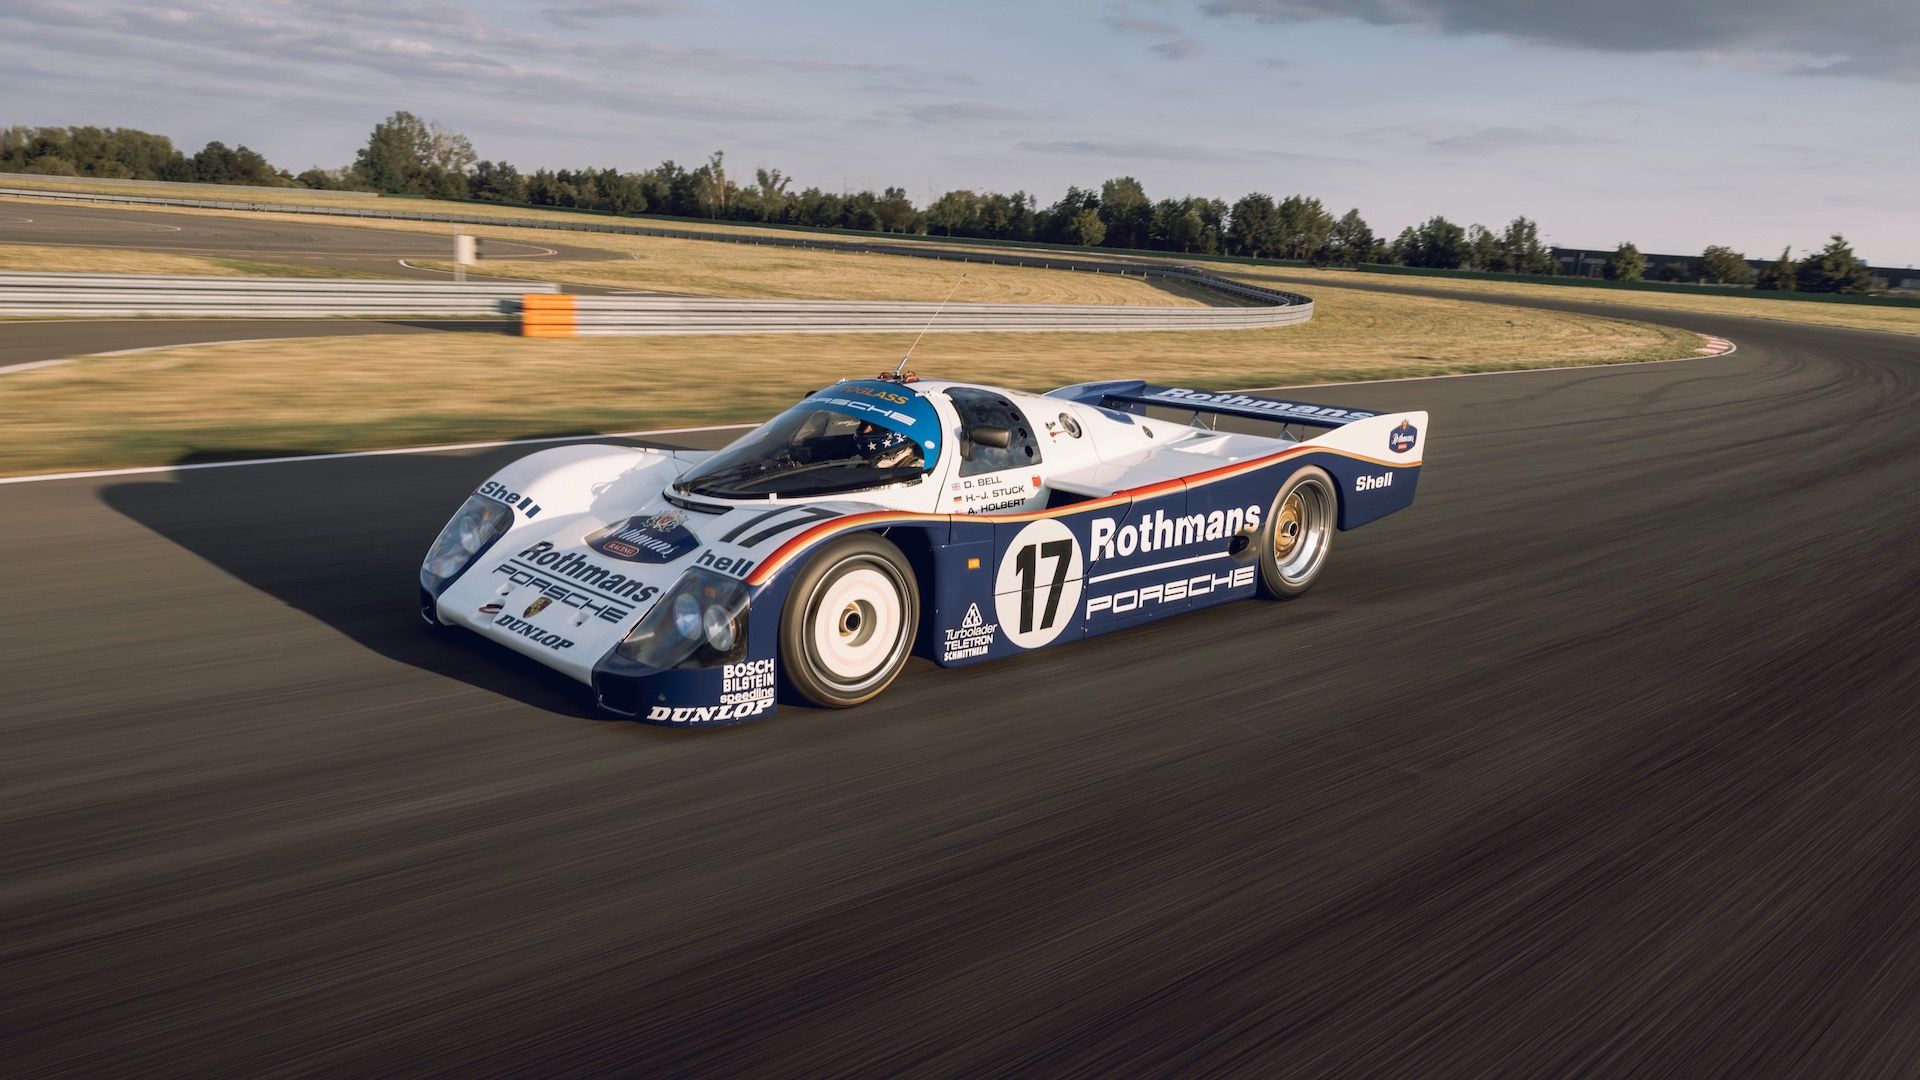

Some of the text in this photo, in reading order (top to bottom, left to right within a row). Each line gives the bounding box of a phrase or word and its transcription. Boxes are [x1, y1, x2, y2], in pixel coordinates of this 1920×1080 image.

[1156, 387, 1375, 420] Rothmans
[964, 476, 1002, 489] D. BELL
[992, 485, 1025, 498] STUCK
[1355, 472, 1393, 491] Shell
[480, 481, 541, 519] Shell
[968, 498, 1026, 515] A. HOLBERT
[1090, 504, 1261, 562] Rothmans
[518, 541, 659, 602] Rothmans
[696, 549, 754, 577] hell
[492, 564, 628, 624] PORSCHE
[1015, 538, 1073, 635] 17
[1086, 565, 1255, 620] PORSCHE
[495, 614, 575, 650] DUNLOP
[944, 634, 993, 651] TELETRON
[945, 623, 998, 641] Turbolader
[723, 658, 775, 679] BOSCH
[722, 672, 775, 693] BILSTEIN
[720, 687, 775, 704] speedline
[647, 698, 775, 722] DUNLOP
